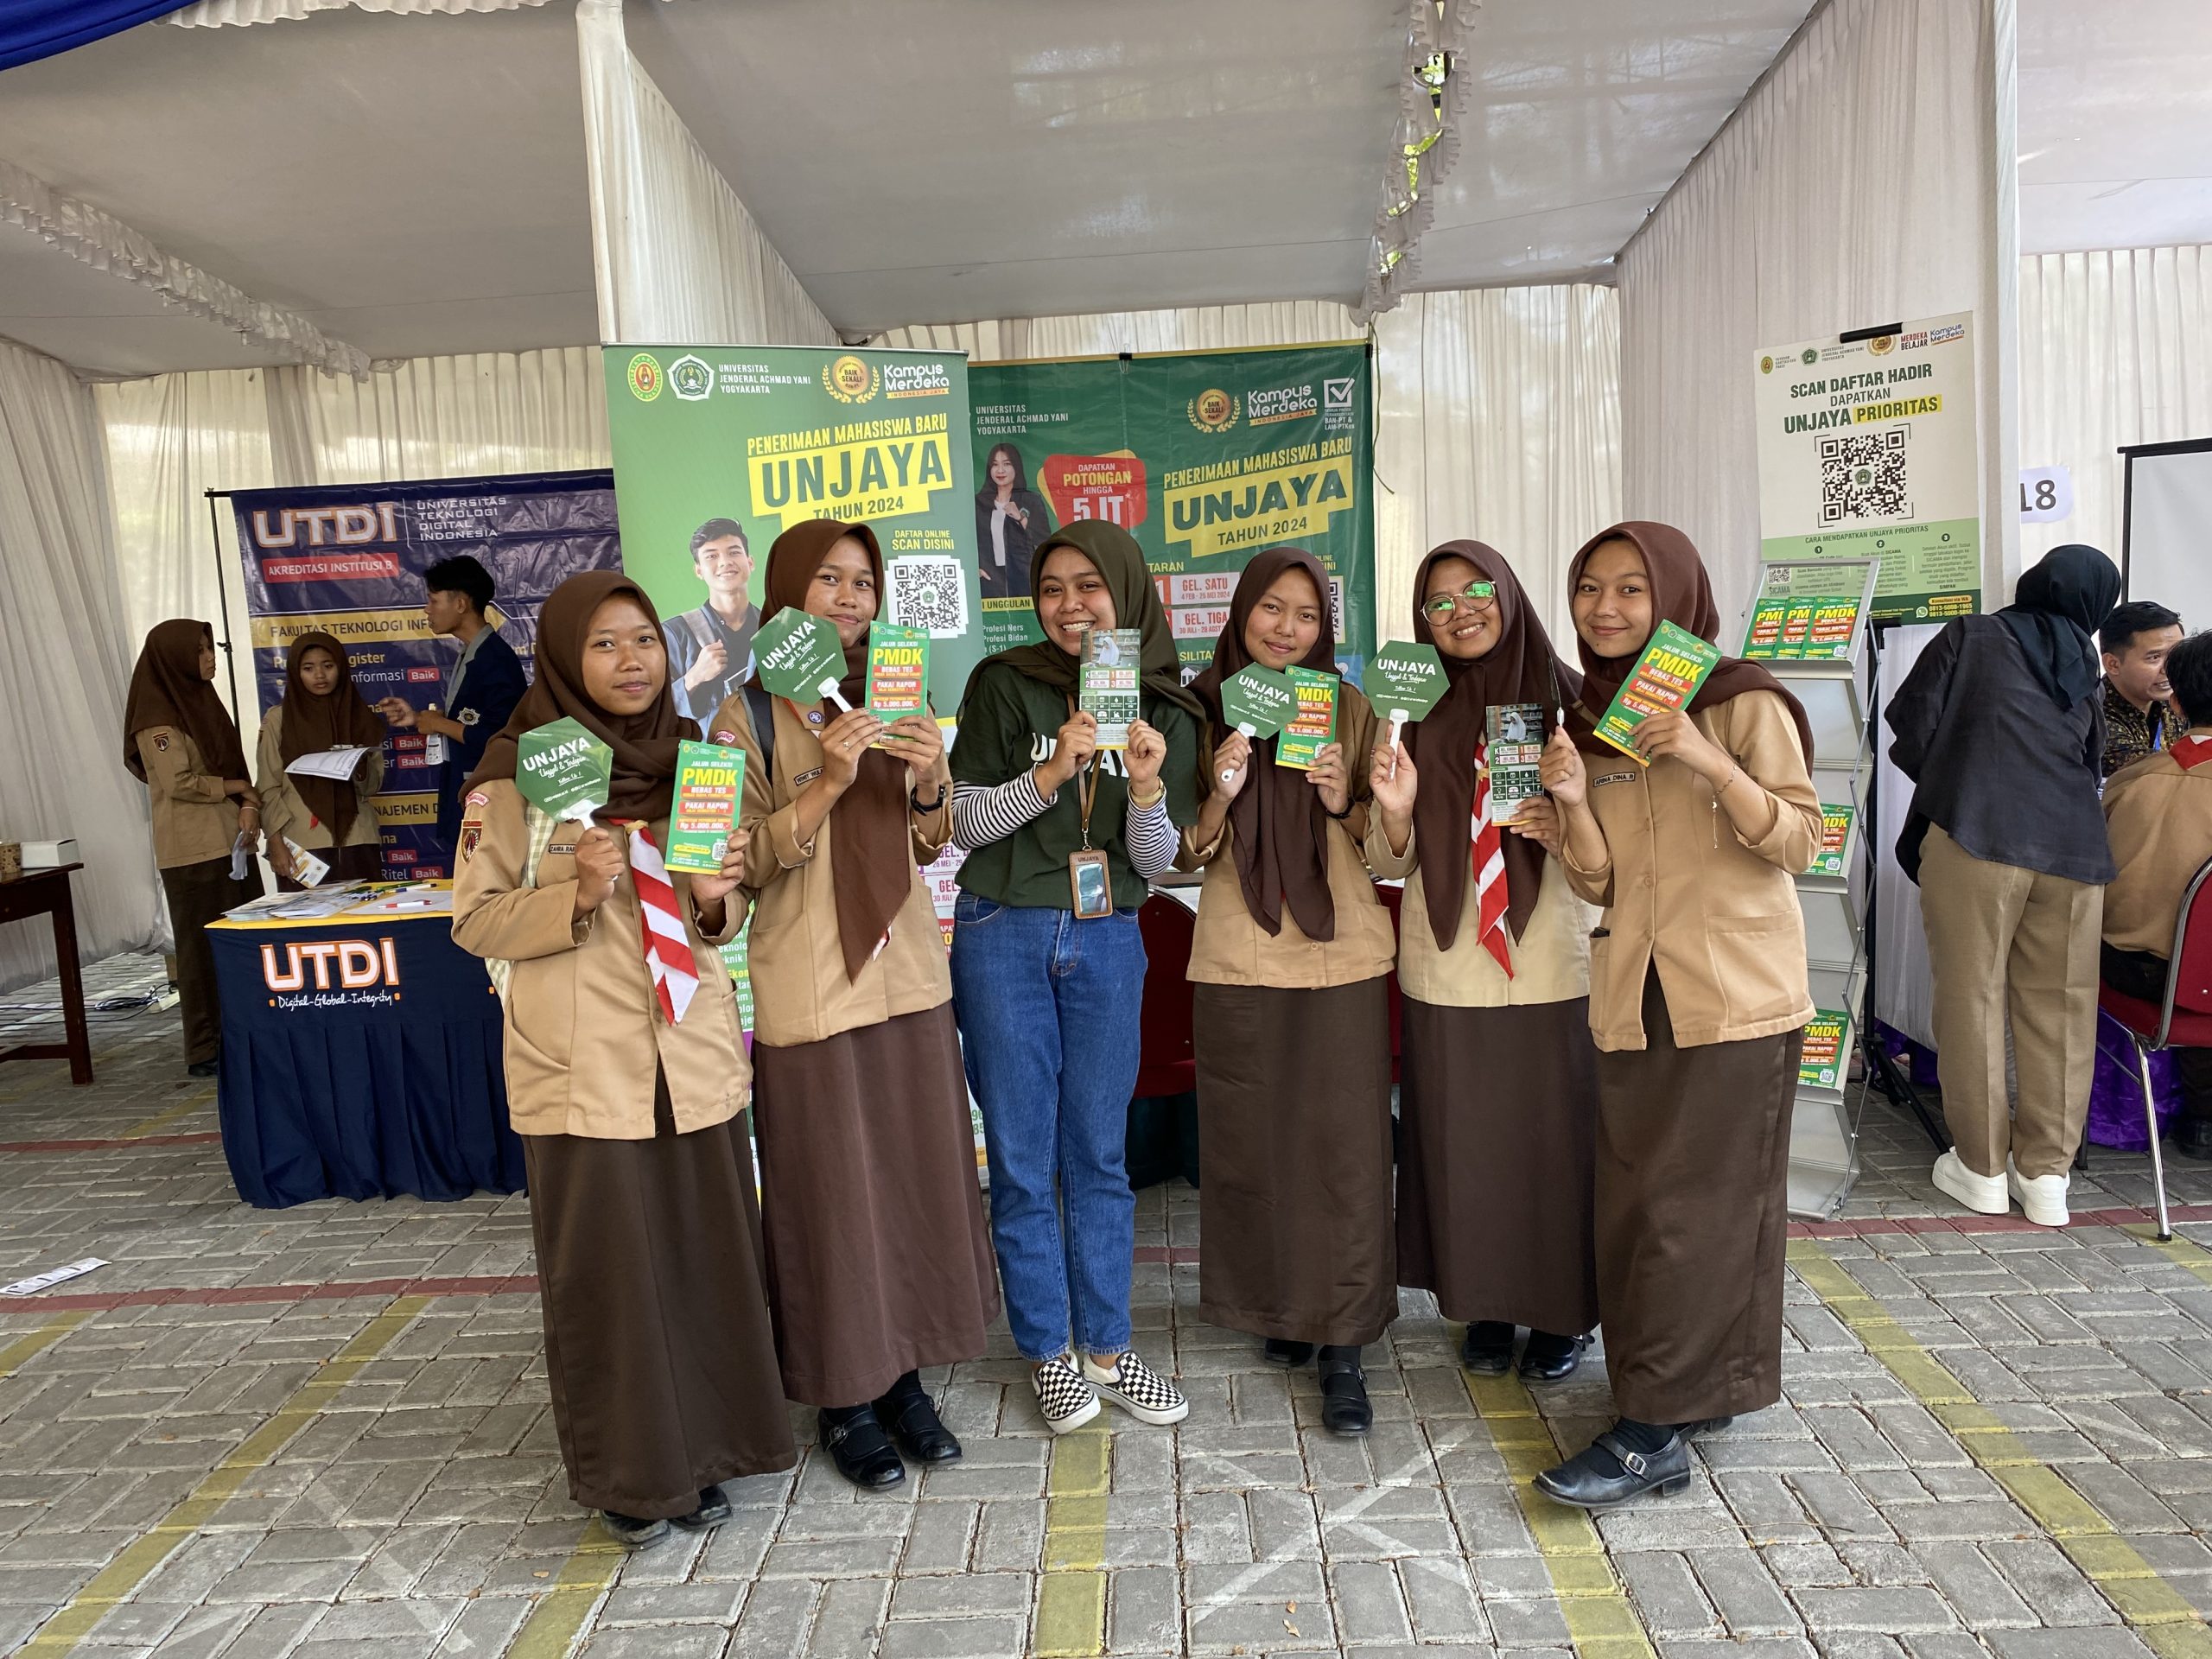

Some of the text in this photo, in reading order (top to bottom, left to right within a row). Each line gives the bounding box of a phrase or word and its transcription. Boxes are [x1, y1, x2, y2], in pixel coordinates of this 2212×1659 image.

[1901, 332, 1928, 342] MERDEKA
[1930, 324, 1962, 337] Kampus
[1930, 330, 1965, 342] Merdeka
[1901, 340, 1928, 351] BELAJAR
[718, 364, 769, 373] UNIVERSITAS
[883, 364, 944, 378] Kampus
[719, 374, 811, 385] JENDERAL ACHMAD YANI
[885, 375, 950, 391] Merdeka
[1790, 363, 1932, 398] SCAN DAFTAR HADIR
[720, 385, 771, 394] YOGYAKARTA
[1248, 385, 1312, 405] Kampus
[1830, 387, 1891, 407] DAPATKAN
[976, 404, 1026, 415] UNIVERSITAS
[1249, 397, 1317, 419] Merdeka
[976, 413, 1069, 425] JENDERAL ACHMAD YANI
[1254, 414, 1293, 425] INDONESIA
[1783, 397, 1938, 434] UNJAYA PRIORITAS
[747, 412, 948, 456] PENERIMAAN MAHASISWA BARU
[976, 425, 1027, 435] YOGYAKARTA
[1078, 463, 1116, 472] DAPATKAN
[1163, 436, 1352, 489] PENERIMAAN MAHASISWA BARU
[761, 439, 946, 508] UNJAYA
[1063, 471, 1132, 486] POTONGAN
[1083, 486, 1113, 494] HINGGA
[2019, 479, 2056, 512] 18
[416, 497, 507, 510] UNIVERSITAS
[1173, 468, 1347, 531] UNJAYA
[417, 508, 498, 520] TEKNOLOGI
[813, 495, 904, 519] TAHUN 2024
[252, 501, 397, 549] UTDI
[419, 520, 473, 531] DIGITAL
[1217, 516, 1307, 545] TAHUN 2024
[420, 529, 499, 541] INDONESIA
[894, 530, 950, 538] DAFTAR ONLINE
[1822, 531, 1868, 541] MENDAPATKAN
[1894, 525, 1929, 534] PRIORITAS
[892, 538, 955, 550] SCAN DISINI
[269, 560, 392, 576] AKREDITASI INSTITUSI B
[1182, 577, 1228, 591] GEL. SATU
[987, 599, 1030, 609] UNGGULAN
[1185, 612, 1227, 626] GEL. TIGA
[1815, 607, 1858, 620] PMDK
[330, 620, 404, 634] TEKNOLOGI
[982, 624, 1006, 632] Profesi
[761, 620, 817, 671] UNJAYA
[1662, 643, 1682, 657] JALUR
[873, 648, 924, 665] PMDK
[1377, 658, 1436, 676] UNJAYA
[1644, 647, 1705, 683] PMDK
[411, 671, 435, 681] Baik
[1649, 668, 1673, 681] BEBAS
[876, 680, 917, 689] PAKAI RAPOR
[1238, 674, 1290, 704] UNJAYA
[1636, 680, 1679, 702] PAKAI RAPOR
[1295, 686, 1333, 702] MDK
[874, 701, 881, 709] Rp
[399, 737, 423, 749] Baik
[522, 737, 592, 772] UNJAYA
[401, 757, 424, 767] Baik
[682, 767, 738, 786] PMDK
[684, 802, 705, 810] PAKAI
[391, 852, 414, 863] Baik
[381, 868, 439, 881] Ritel Baik
[939, 879, 961, 893] GEL.
[941, 893, 952, 902] JULI
[260, 937, 399, 992] UTDI
